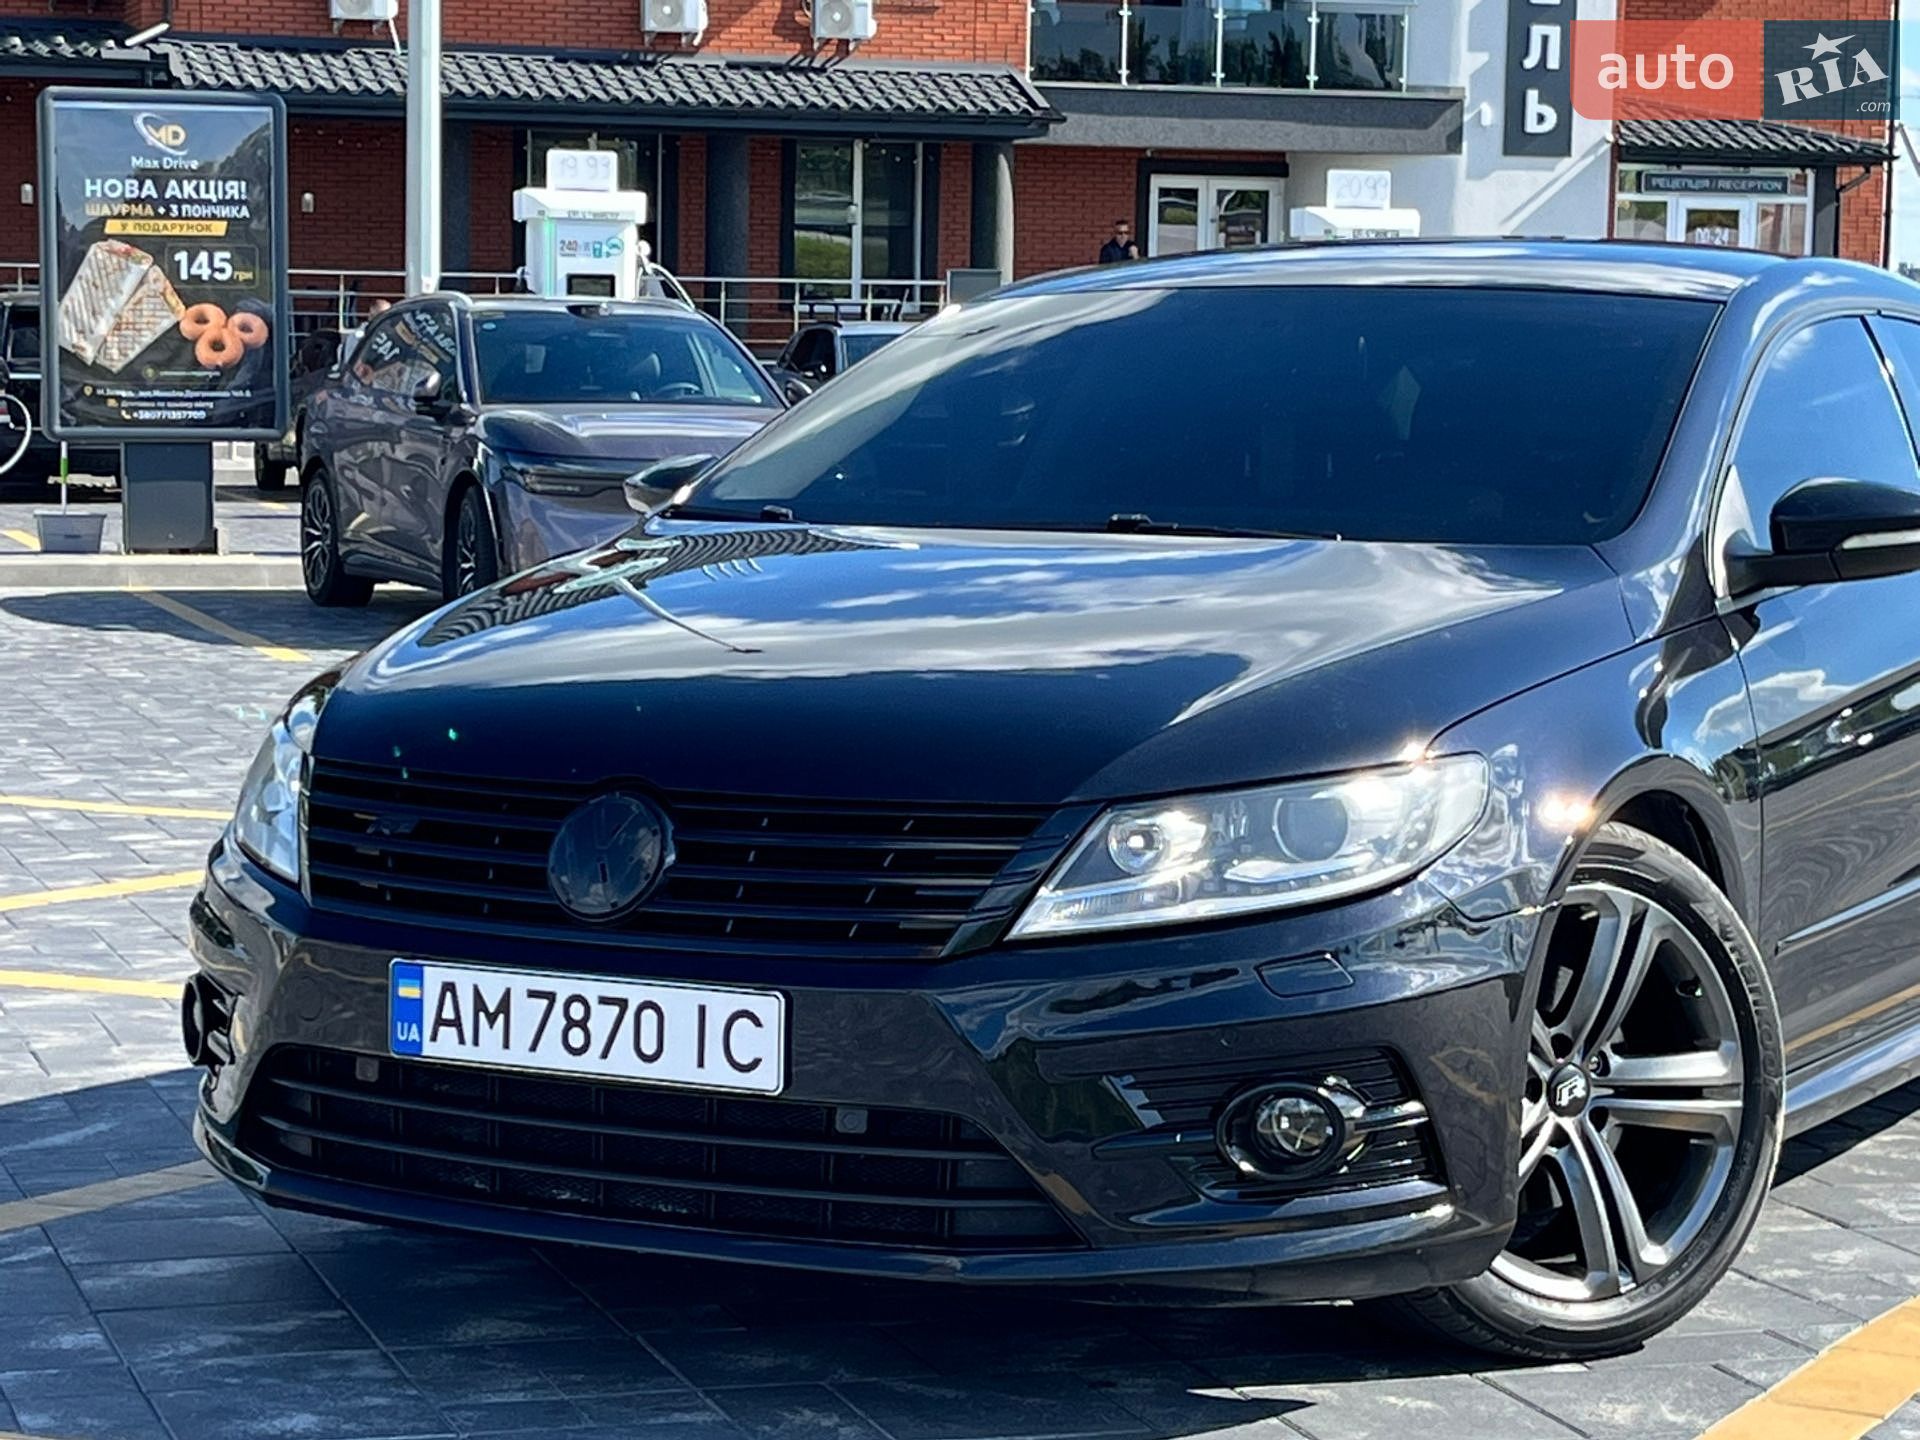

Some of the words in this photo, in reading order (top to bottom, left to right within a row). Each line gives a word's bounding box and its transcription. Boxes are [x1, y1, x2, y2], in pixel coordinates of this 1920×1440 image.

[1522, 0, 1561, 134] ЛЬ
[131, 156, 159, 169] Max
[163, 157, 200, 170] Drive
[85, 178, 158, 199] НОВА
[165, 179, 248, 203] АКЦІЯ!
[1718, 179, 1783, 192] RECEPTION
[85, 203, 154, 216] ШАУРМА
[169, 204, 178, 217] 3
[181, 204, 250, 218] ПОНЧИКА
[120, 223, 128, 232] У
[133, 222, 213, 233] ПОДАРУНОК
[173, 250, 233, 281] 145
[397, 1022, 421, 1043] UA
